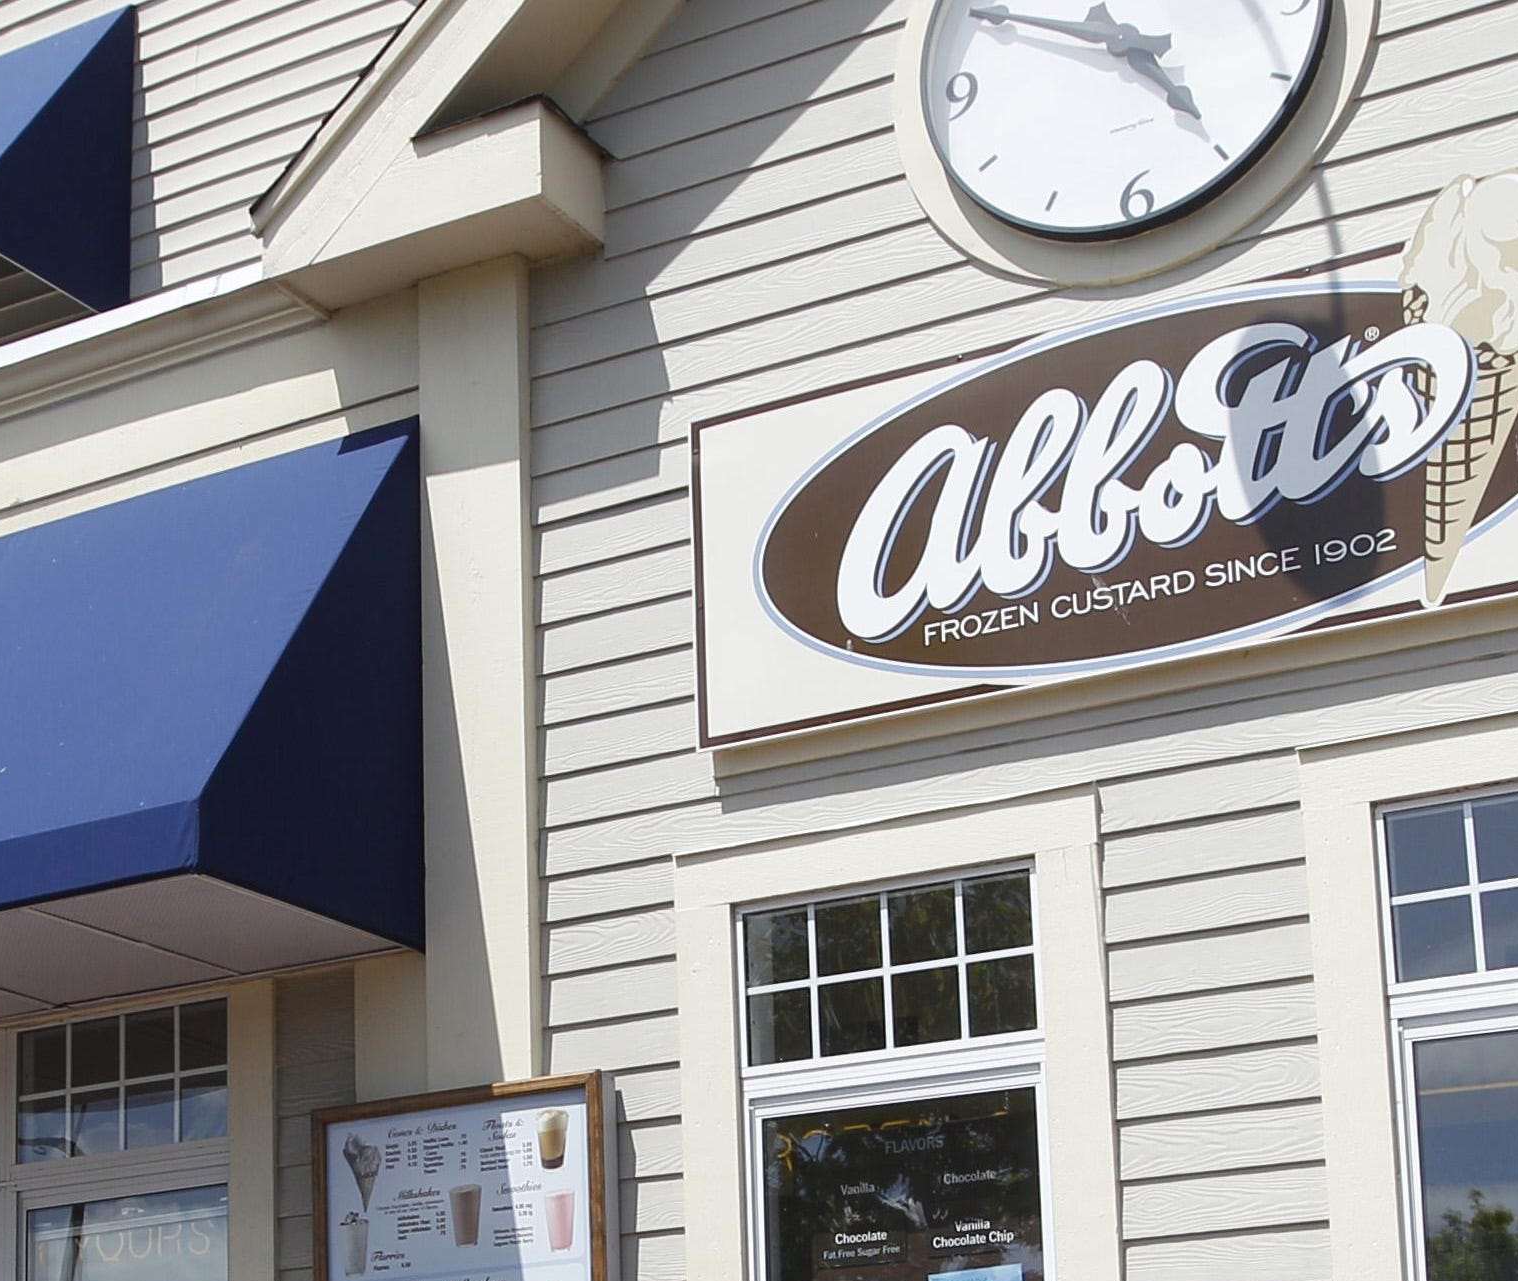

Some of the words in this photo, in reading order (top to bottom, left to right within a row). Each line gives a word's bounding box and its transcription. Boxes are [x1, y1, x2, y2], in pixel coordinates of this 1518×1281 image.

[946, 72, 979, 121] 9
[1119, 170, 1155, 221] 6
[924, 601, 1040, 647] FROZEN
[1051, 570, 1196, 620] CUSTARD
[1204, 547, 1301, 588] SINCE
[1314, 527, 1398, 566] 1902
[884, 1136, 945, 1154] FLAVORS
[943, 1169, 996, 1185] Chocolate
[840, 1182, 875, 1196] Vanilla
[954, 1219, 990, 1233] Vanilla
[835, 1230, 888, 1245] Chocolate
[933, 1233, 987, 1249] Chocolate
[988, 1229, 1014, 1245] Chip
[823, 1250, 837, 1260] Fat
[837, 1249, 856, 1260] Free
[857, 1247, 881, 1259] Sugar
[882, 1245, 900, 1256] Free
